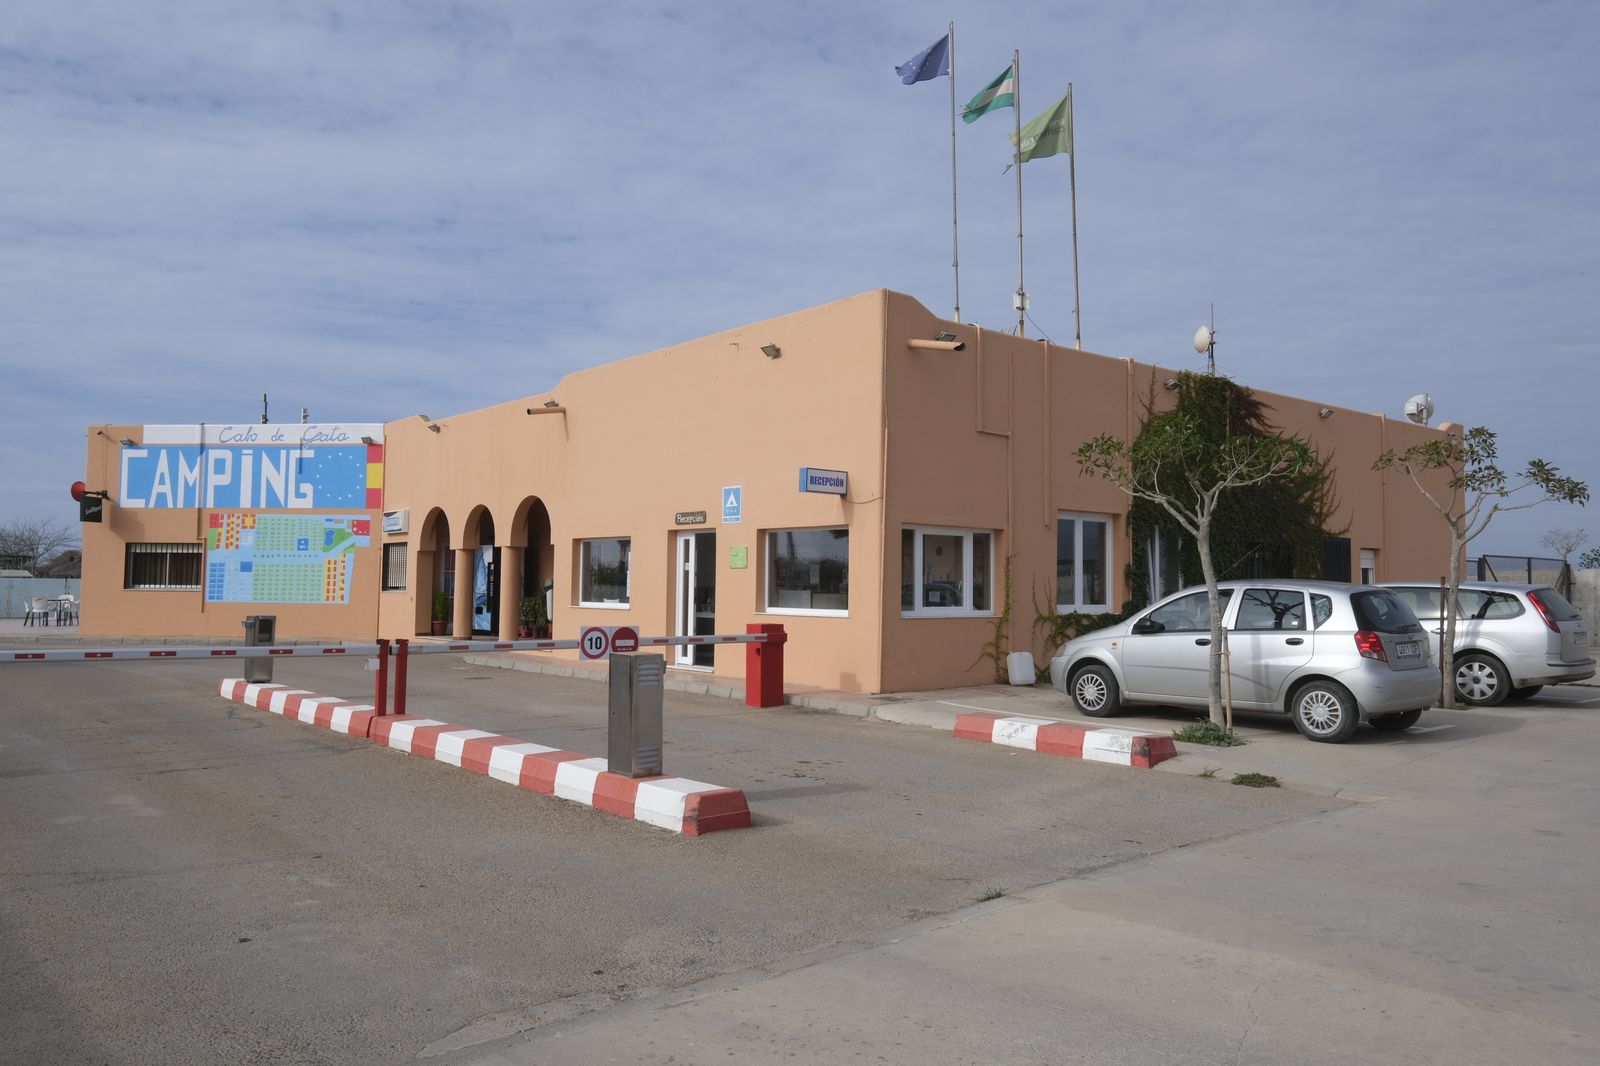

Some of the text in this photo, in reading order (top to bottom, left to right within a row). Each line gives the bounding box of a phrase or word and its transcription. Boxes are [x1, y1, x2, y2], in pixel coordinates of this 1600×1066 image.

[219, 426, 258, 443] Cabo
[270, 428, 285, 441] de
[588, 636, 602, 650] 10
